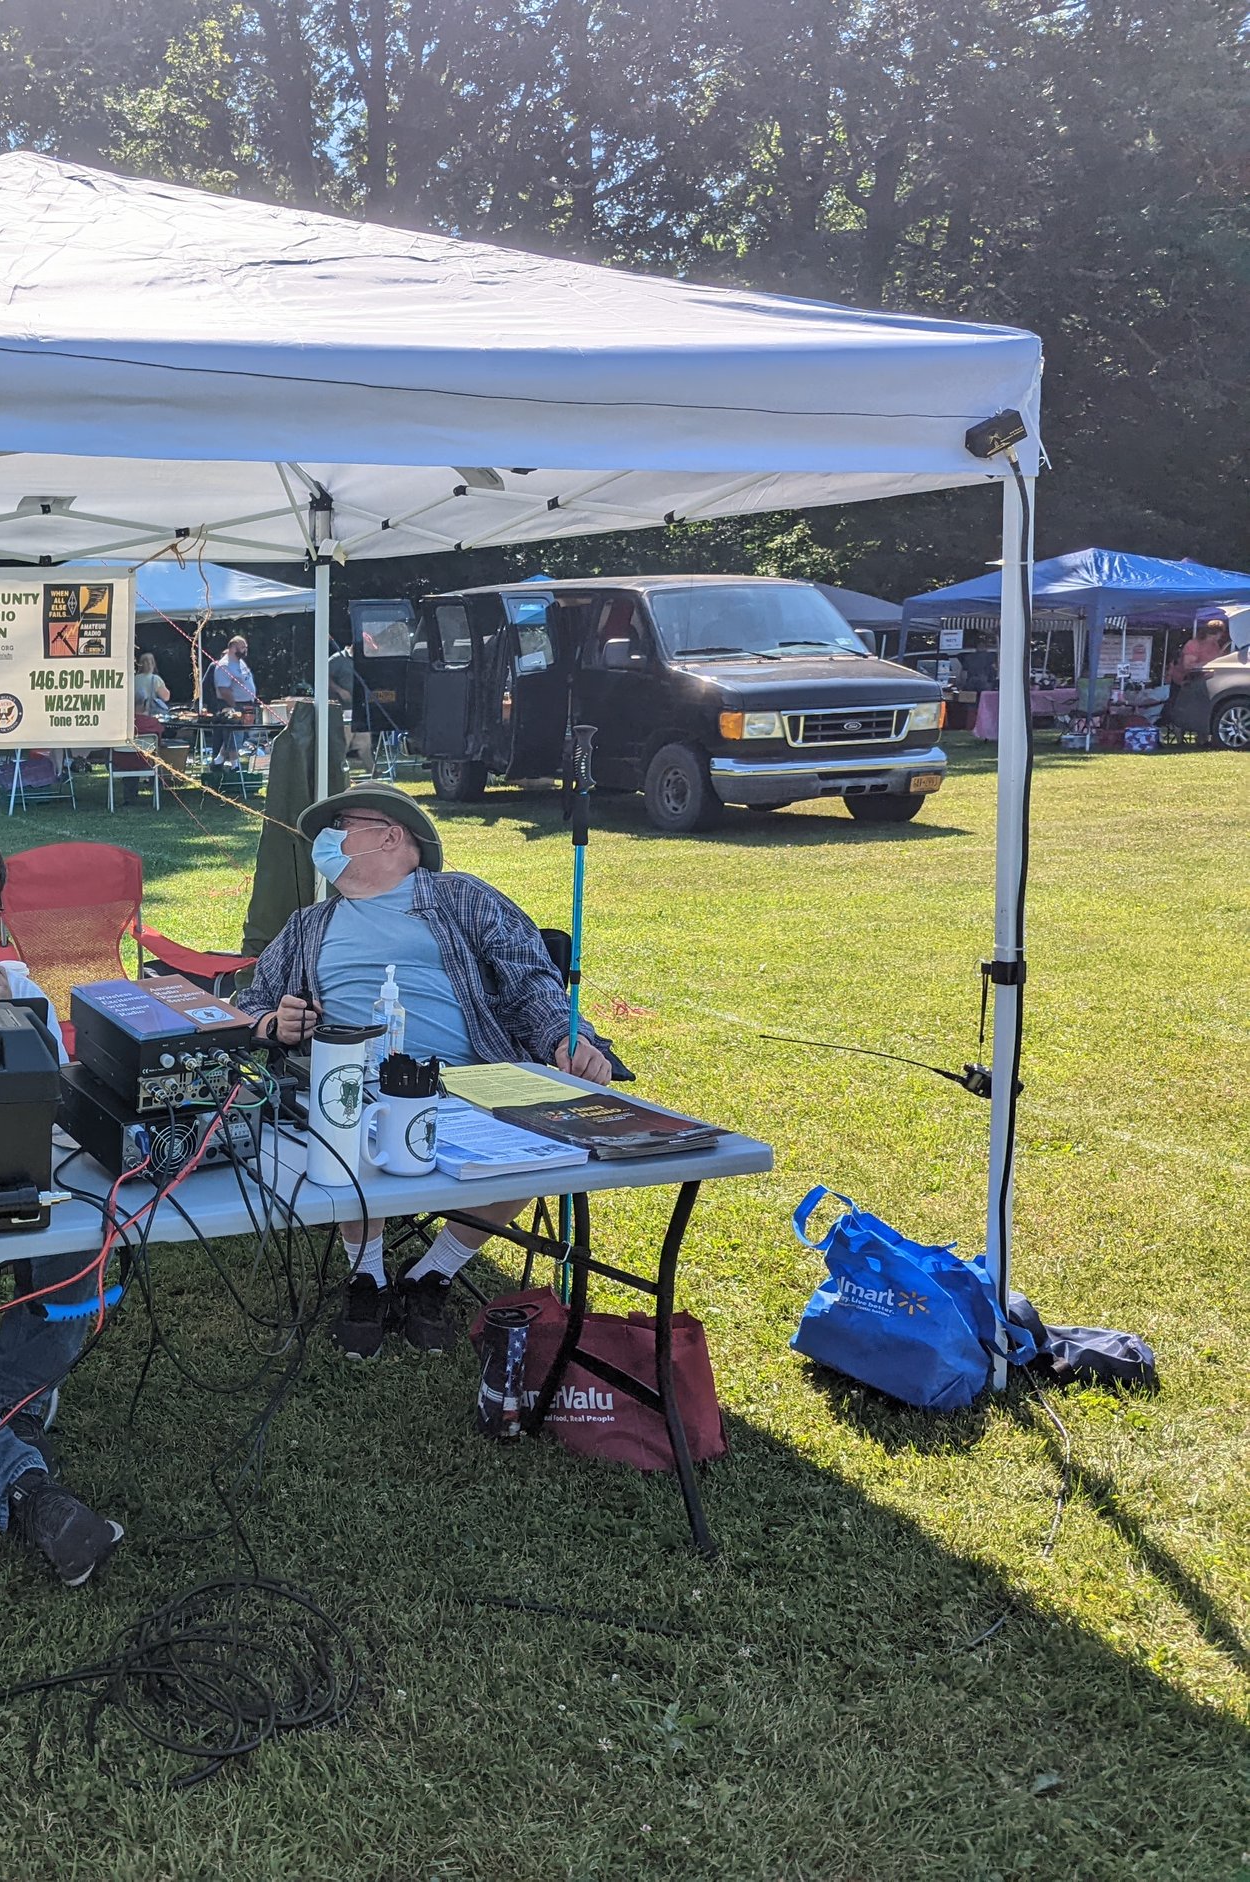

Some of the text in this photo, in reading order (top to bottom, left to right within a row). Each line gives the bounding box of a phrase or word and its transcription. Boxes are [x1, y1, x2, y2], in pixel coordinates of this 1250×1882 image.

[29, 669, 124, 691] 146.610-MHz
[44, 694, 106, 712] WA2ZWM
[49, 714, 99, 727] Tone 123.0
[836, 1276, 895, 1306] lmart
[851, 1296, 867, 1305] Live
[586, 1415, 615, 1423] People
